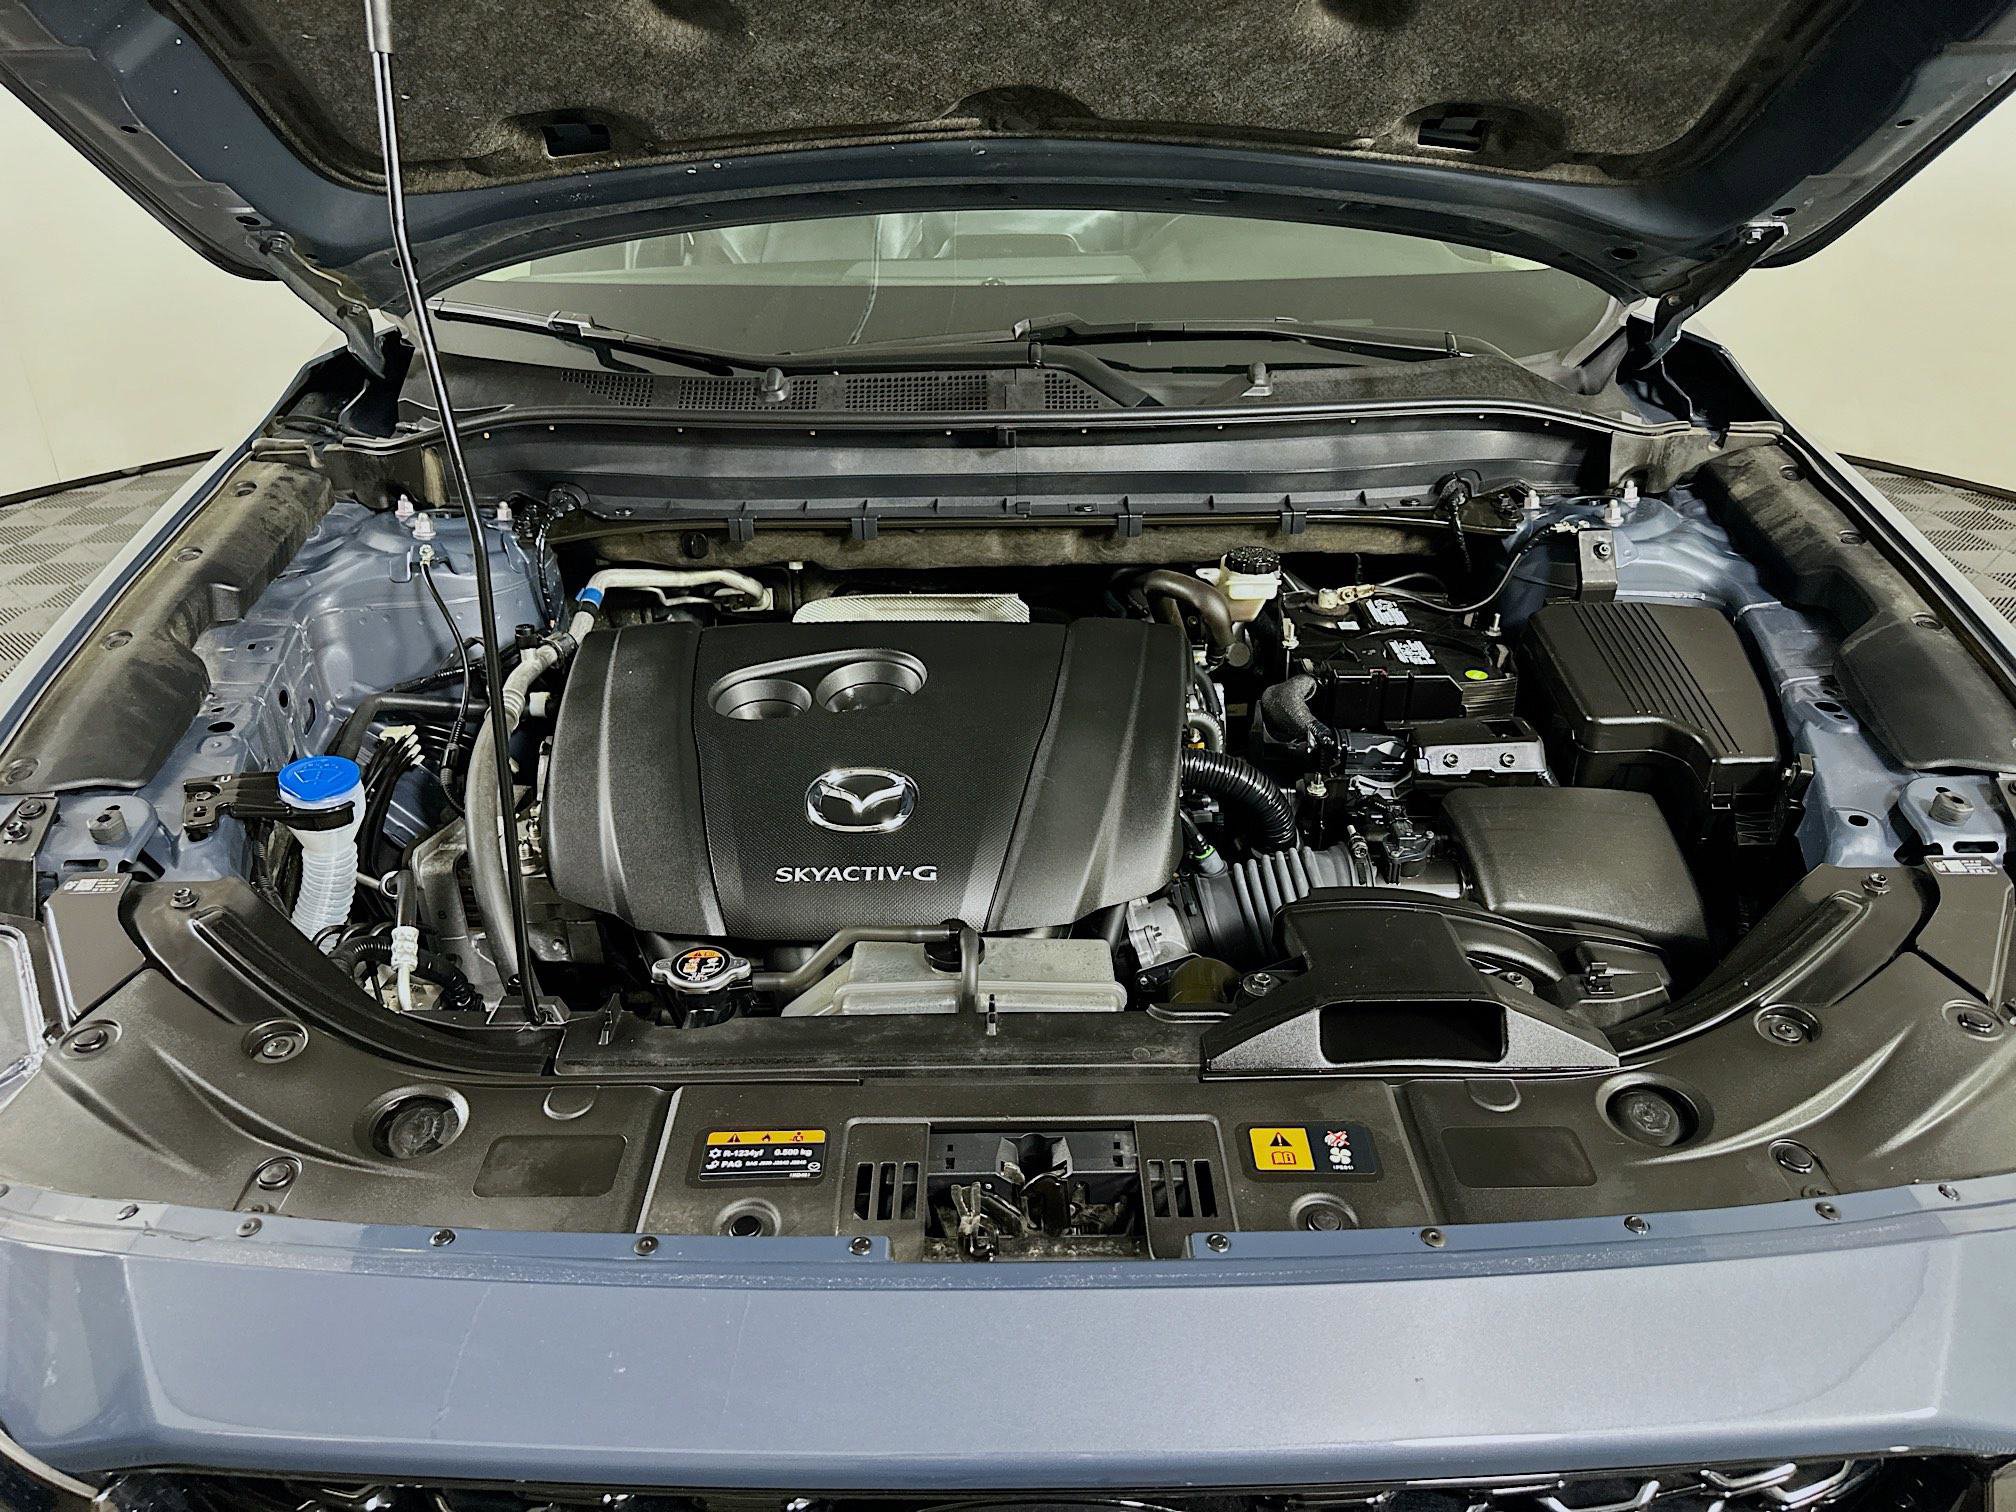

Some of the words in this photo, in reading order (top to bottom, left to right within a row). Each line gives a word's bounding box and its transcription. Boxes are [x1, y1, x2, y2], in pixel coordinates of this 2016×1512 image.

[775, 865, 938, 883] SKYACTIV-G
[723, 1149, 764, 1158] R-1234yf
[800, 1148, 813, 1158] kg
[721, 1160, 742, 1168] PAG
